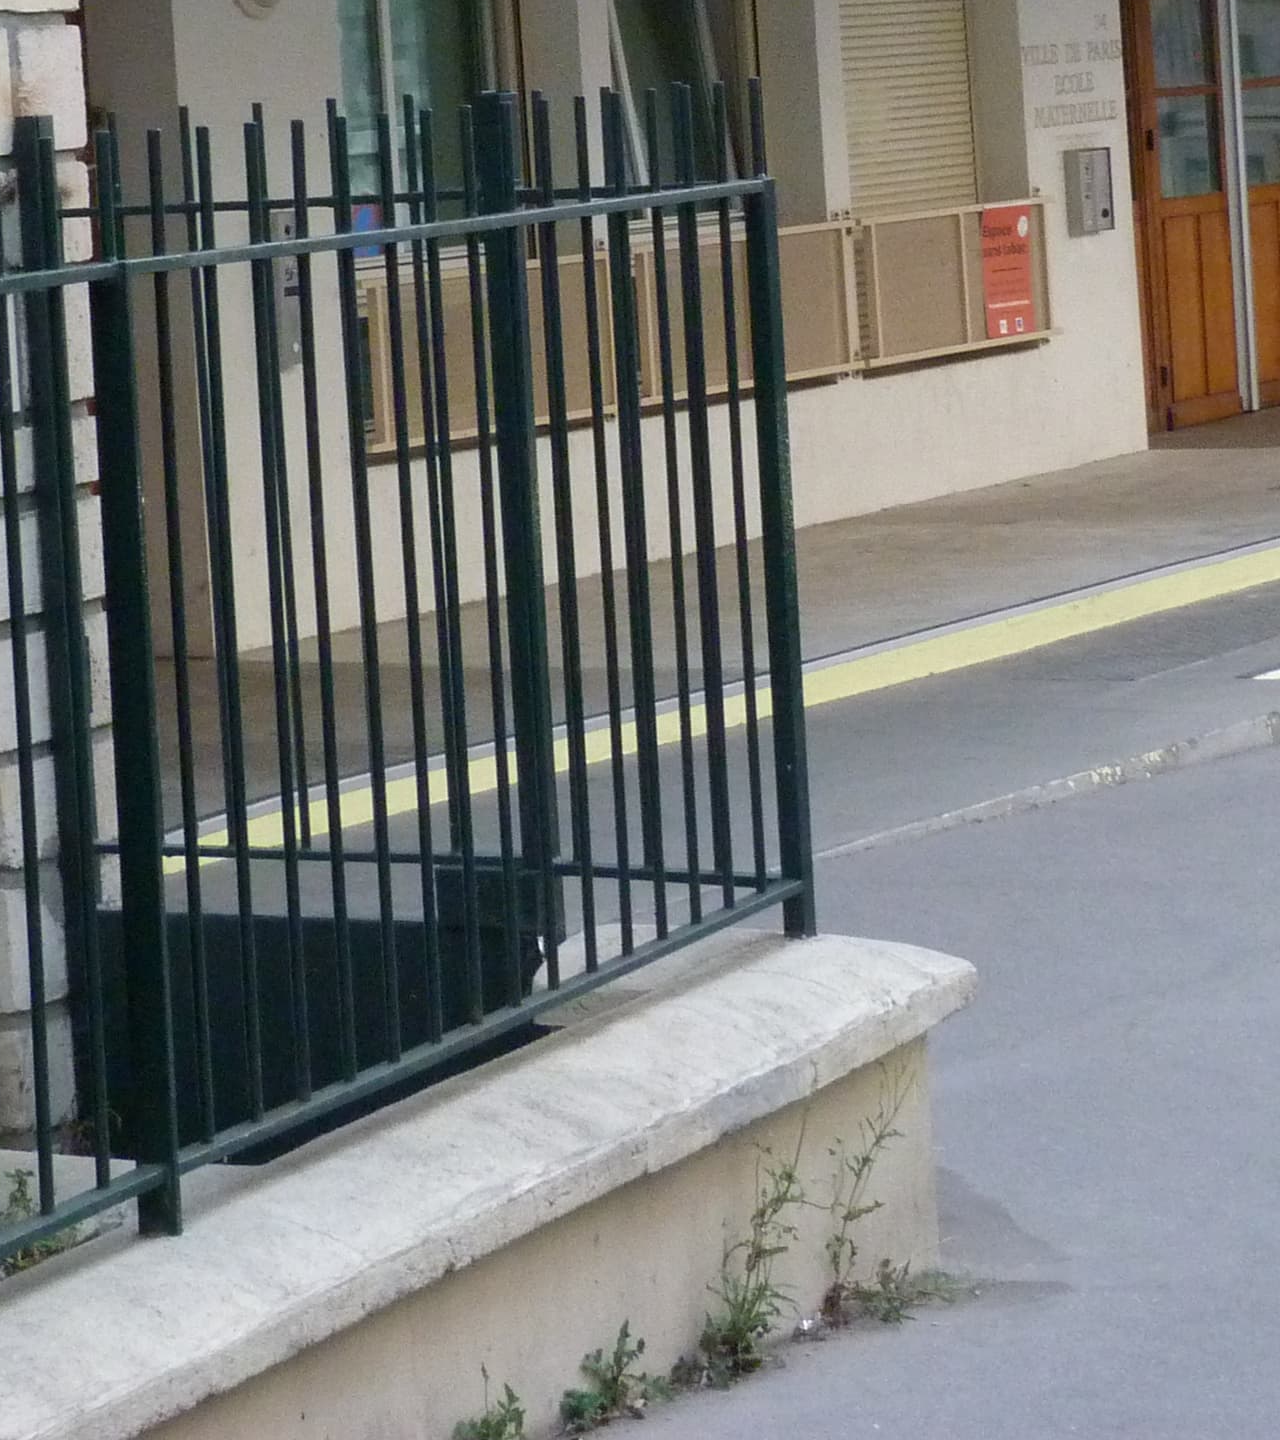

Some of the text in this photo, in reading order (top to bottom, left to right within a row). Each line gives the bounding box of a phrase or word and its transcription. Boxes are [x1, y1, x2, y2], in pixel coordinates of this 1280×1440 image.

[1020, 39, 1121, 65] VILLE DE PARIS
[1034, 100, 1117, 128] MATERNELLE
